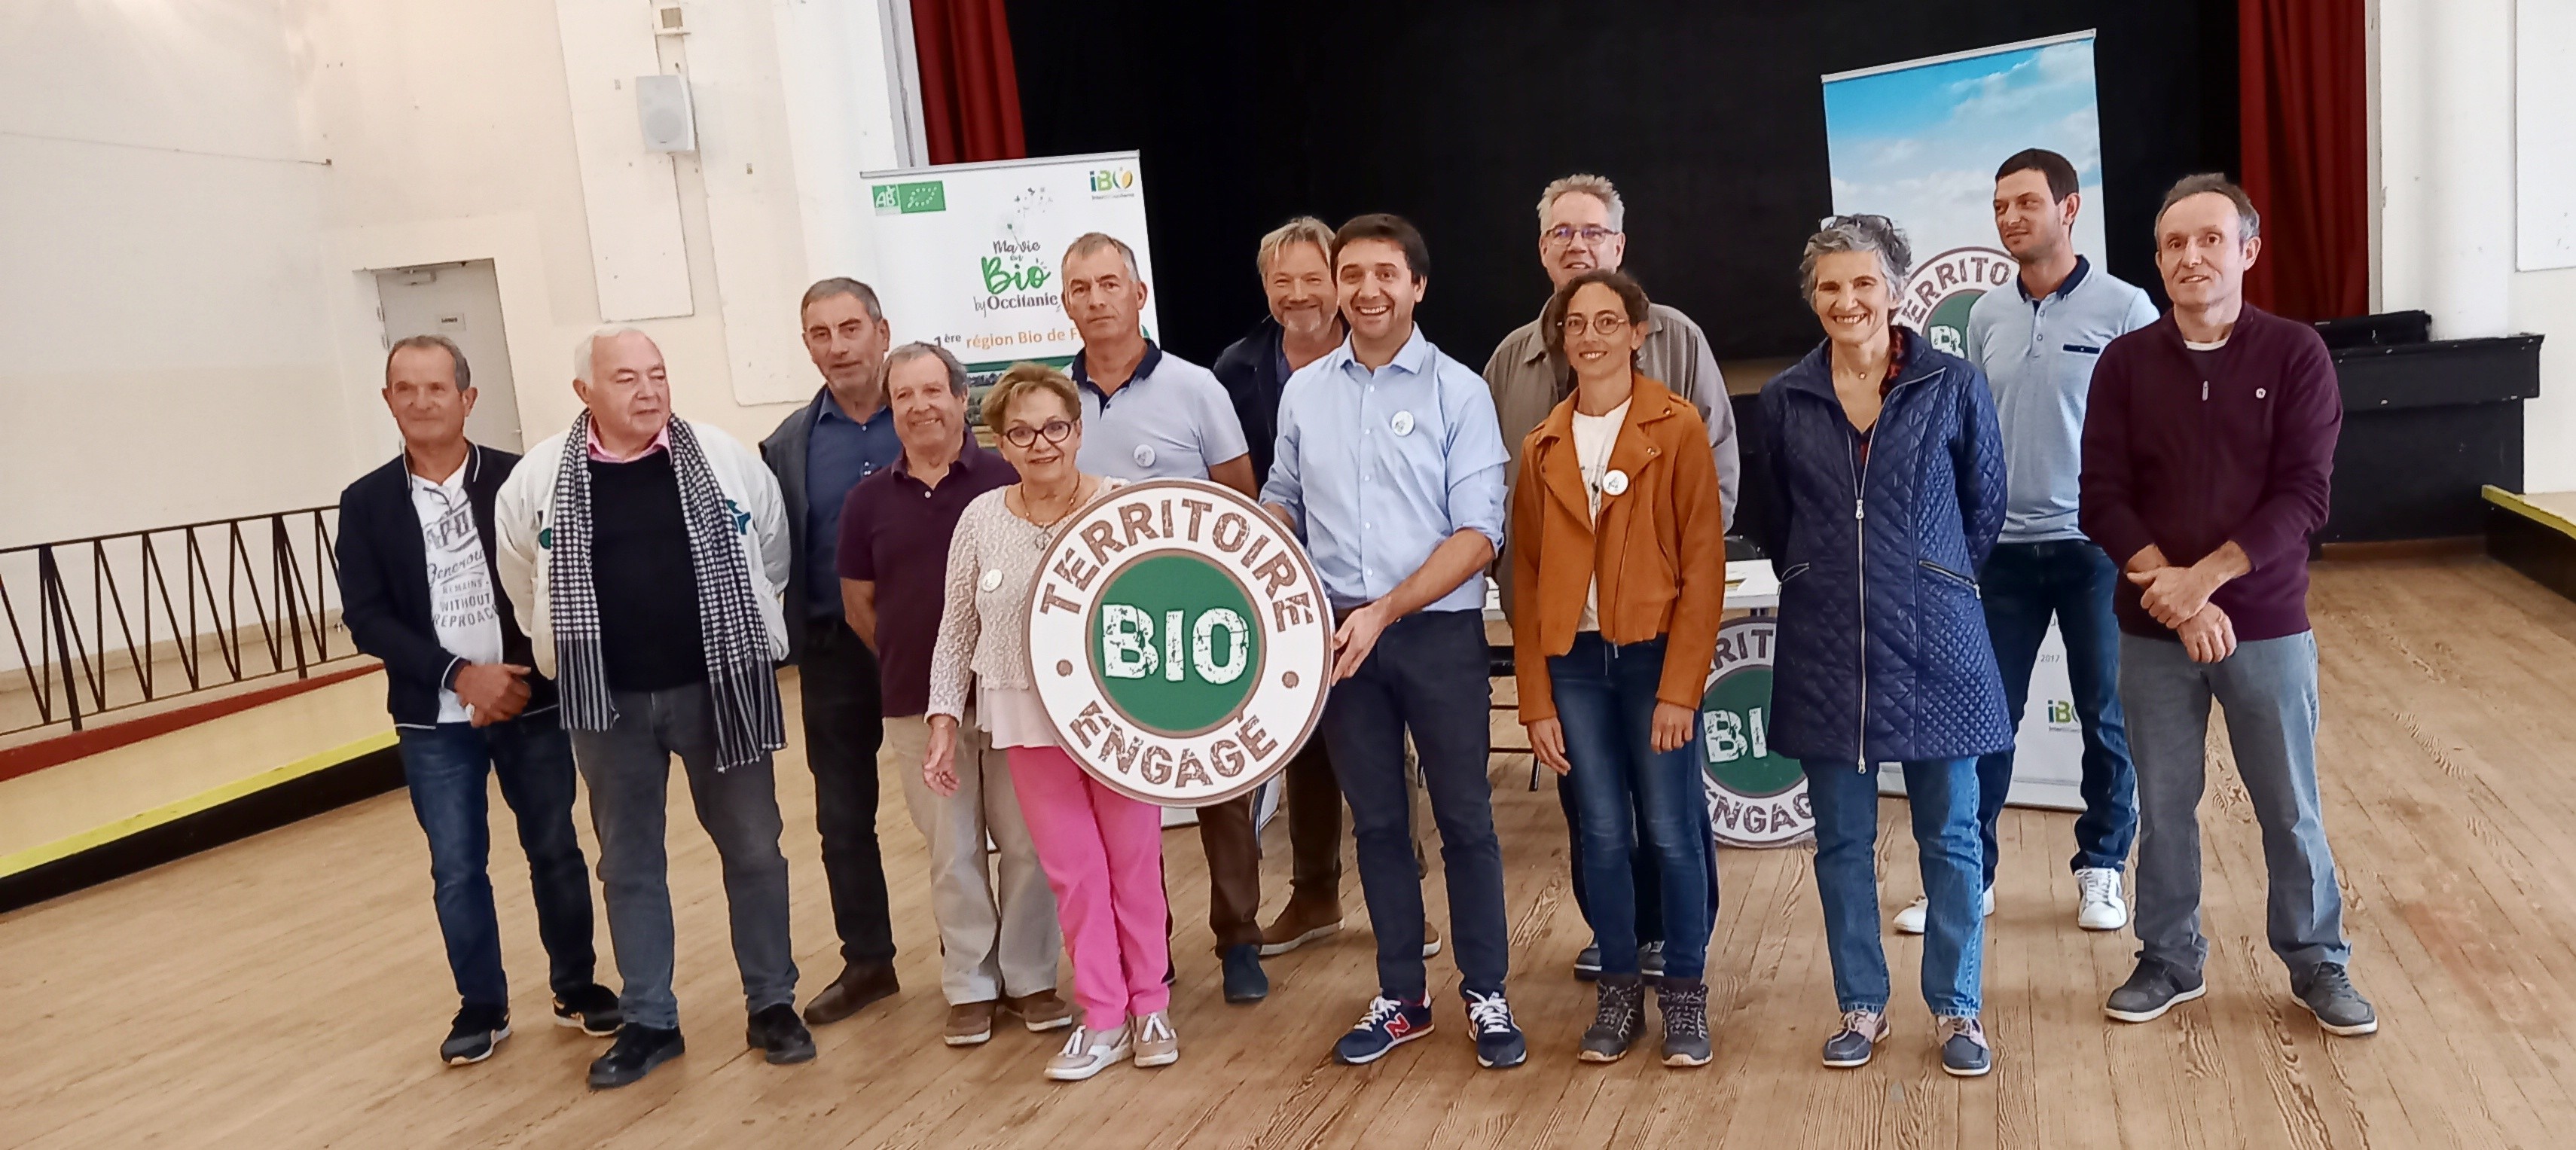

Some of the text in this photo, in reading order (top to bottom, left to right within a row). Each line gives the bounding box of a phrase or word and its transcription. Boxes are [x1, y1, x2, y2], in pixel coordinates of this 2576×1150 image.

[981, 256, 1051, 295] Bio
[973, 292, 1058, 319] by Occitanie
[966, 333, 1014, 350] région
[1018, 330, 1042, 343] Bio
[1047, 328, 1066, 340] de
[1040, 498, 1314, 632] TERRITOIRE
[439, 592, 490, 612] WITHOUT
[1100, 602, 1250, 685] BIO
